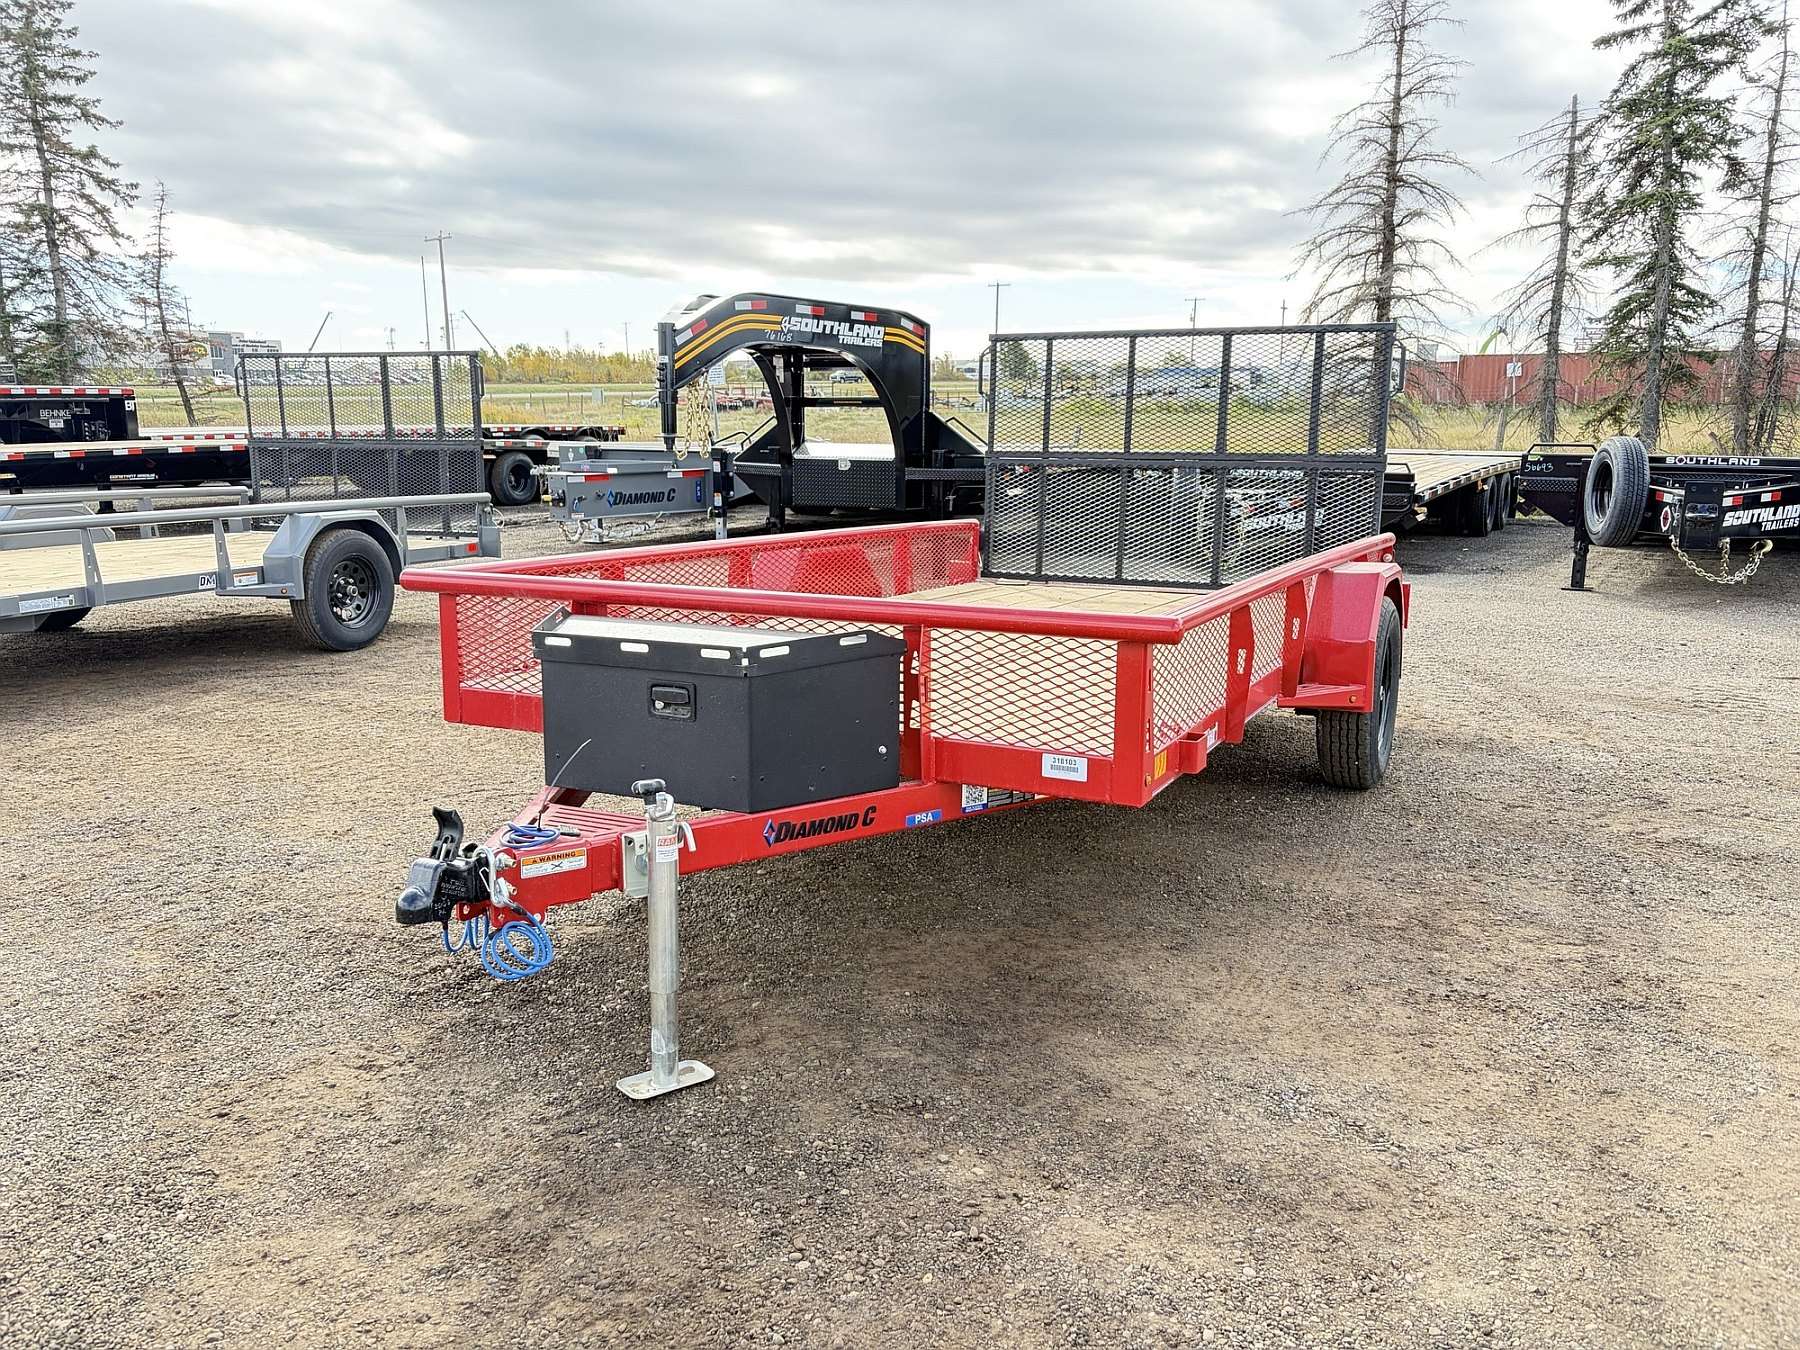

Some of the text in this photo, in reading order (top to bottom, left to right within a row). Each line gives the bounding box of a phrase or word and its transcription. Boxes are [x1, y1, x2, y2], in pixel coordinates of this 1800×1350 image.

[790, 317, 885, 339] SOUTHLAND
[838, 335, 883, 347] TRAILERS
[40, 409, 71, 417] BEHNKE
[1665, 455, 1760, 466] SOUTHLAND
[1524, 462, 1554, 473] 56693
[613, 488, 676, 506] DIAMOND C
[1722, 504, 1800, 527] SOUTHLAND
[1761, 518, 1800, 532] TRAILERS
[914, 812, 933, 824] PSA
[774, 805, 877, 844] DIAMOND C
[539, 851, 576, 863] WARNING
